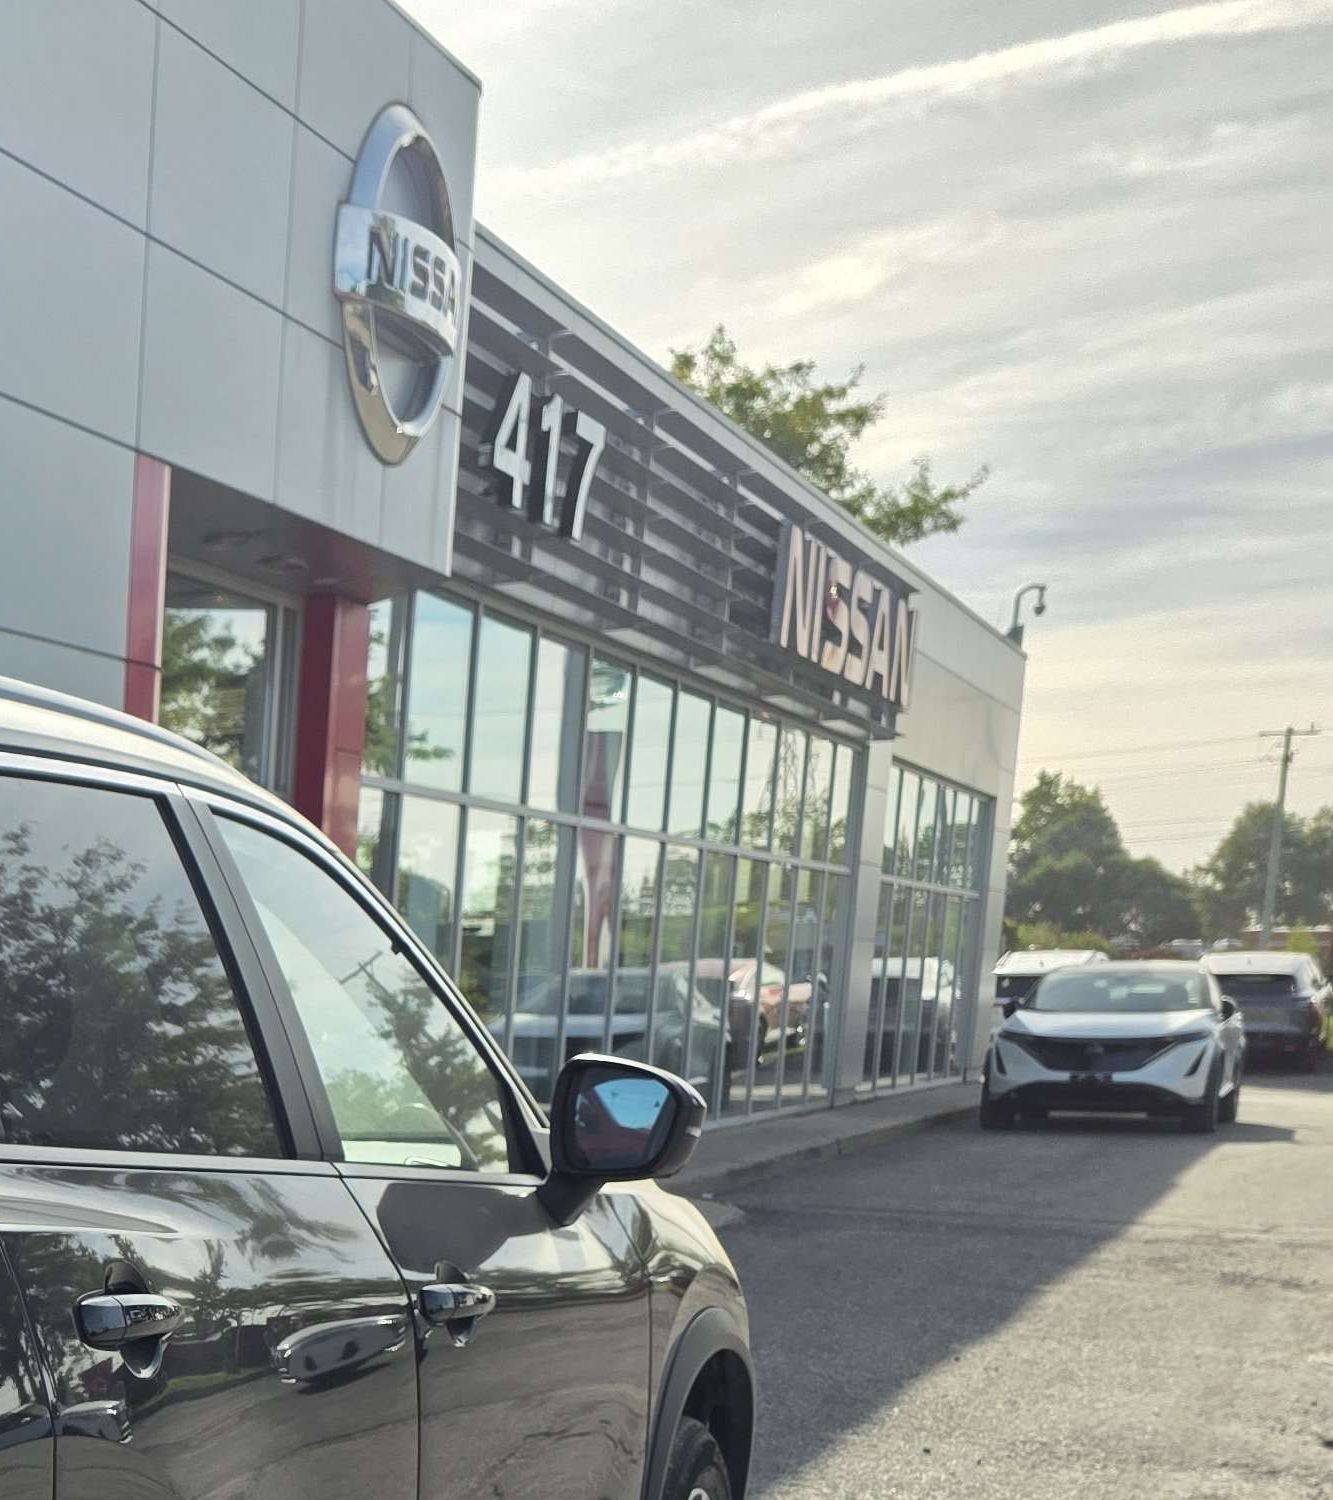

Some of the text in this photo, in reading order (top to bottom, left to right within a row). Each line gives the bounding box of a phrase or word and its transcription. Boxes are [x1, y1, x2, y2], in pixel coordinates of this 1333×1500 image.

[366, 223, 456, 318] NISSA
[493, 371, 918, 711] 417 NISSAN
